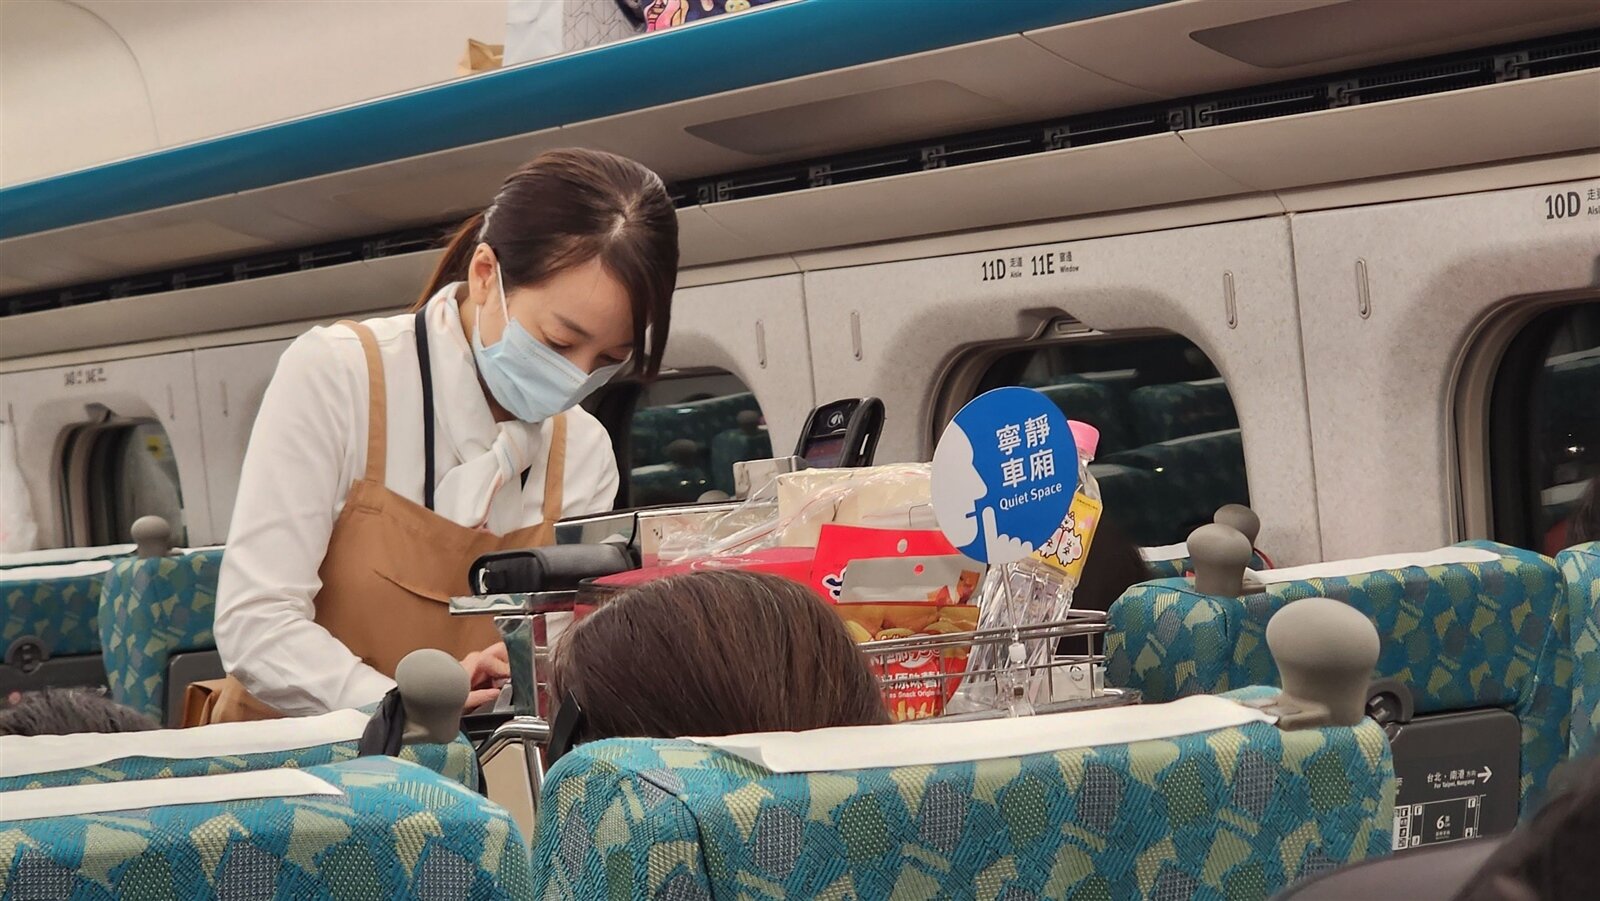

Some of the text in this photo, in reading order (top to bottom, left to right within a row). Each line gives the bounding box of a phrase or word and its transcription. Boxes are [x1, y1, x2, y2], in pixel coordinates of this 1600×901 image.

[1545, 191, 1581, 219] 10D
[982, 258, 1006, 281] 11D
[1031, 253, 1055, 276] 11E
[1060, 265, 1079, 273] Window
[996, 414, 1050, 455] 寧靜
[1001, 449, 1055, 488] 車廂
[1000, 483, 1062, 510] Quiet Space
[1436, 815, 1445, 829] 6
